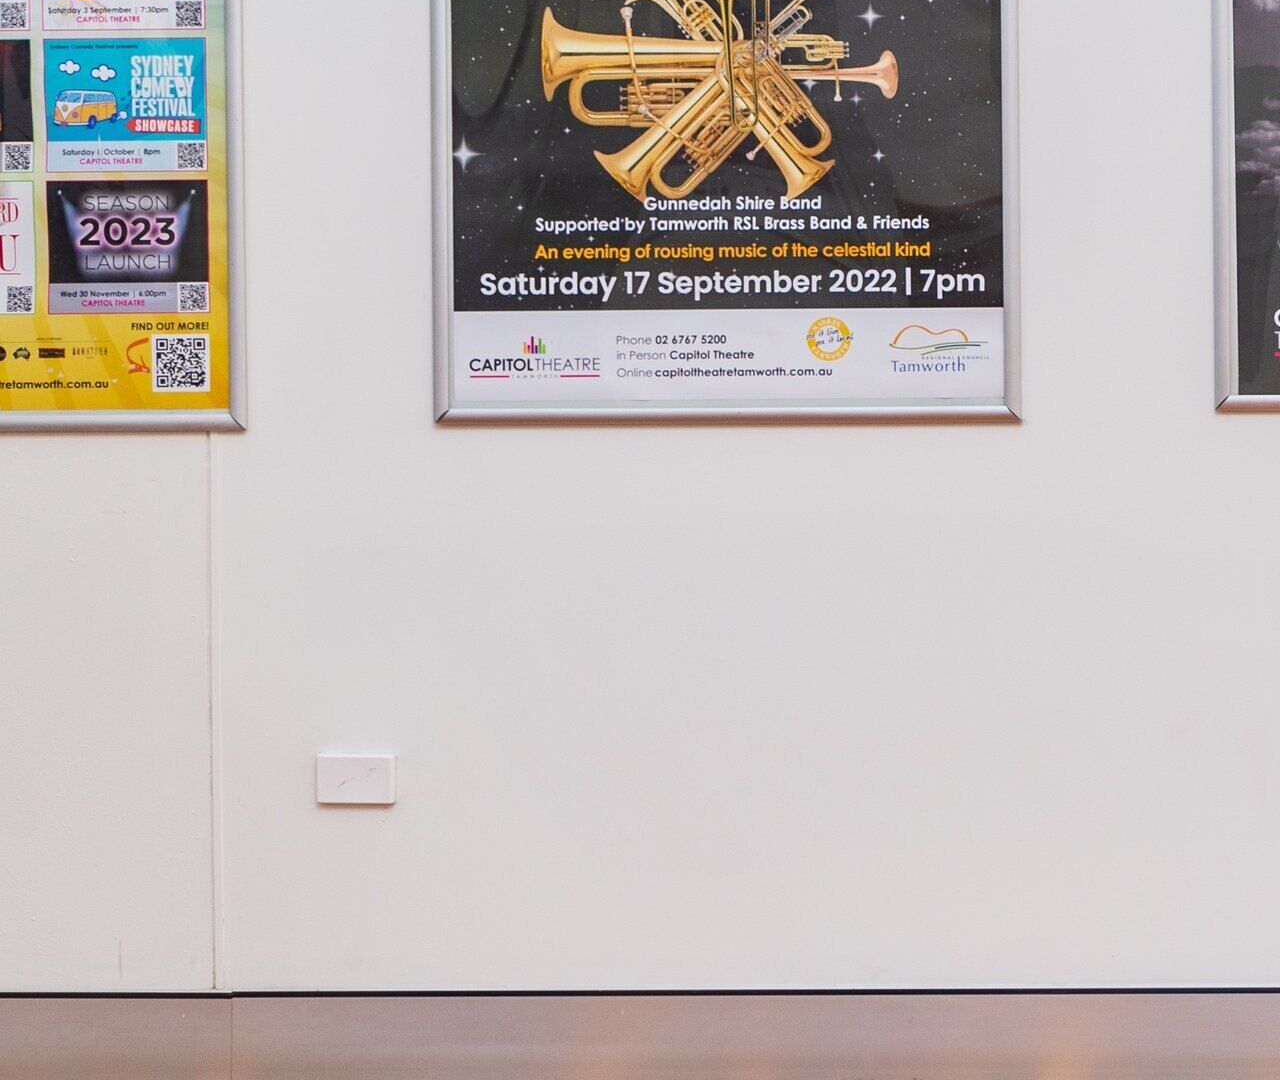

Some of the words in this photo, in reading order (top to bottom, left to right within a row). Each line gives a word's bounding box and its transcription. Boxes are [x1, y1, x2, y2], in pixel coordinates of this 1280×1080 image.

[131, 55, 194, 77] SYDNEY
[131, 76, 195, 98] COMEDY
[132, 98, 195, 117] FESTIVAL
[134, 119, 195, 133] SHOWCASE
[84, 195, 169, 211] SEASON
[643, 196, 731, 211] Gunnedah
[736, 196, 775, 210] Shire
[780, 196, 821, 210] Band
[80, 217, 175, 246] 2023
[535, 217, 620, 235] Supported
[624, 217, 645, 234] by
[650, 216, 728, 231] Tamworth
[733, 216, 759, 231] RSL
[764, 216, 805, 230] Brass
[810, 215, 851, 230] Band
[856, 215, 867, 230] &
[872, 215, 930, 230] Friends
[85, 254, 171, 270] LAUNCH
[480, 271, 617, 302] Saturday
[624, 271, 651, 295] 17
[658, 269, 822, 301] September
[829, 269, 897, 293] 2022
[920, 268, 985, 300] 7pm
[60, 290, 78, 298] Wed
[90, 290, 130, 298] November
[138, 290, 167, 299] 6:00pm
[131, 322, 153, 331] FIND
[156, 322, 175, 331] OUT
[178, 322, 209, 331] MORE!
[891, 356, 966, 372] Tamworth
[616, 367, 653, 378] Online
[655, 366, 833, 379] capitoltheatretamworth.com.au
